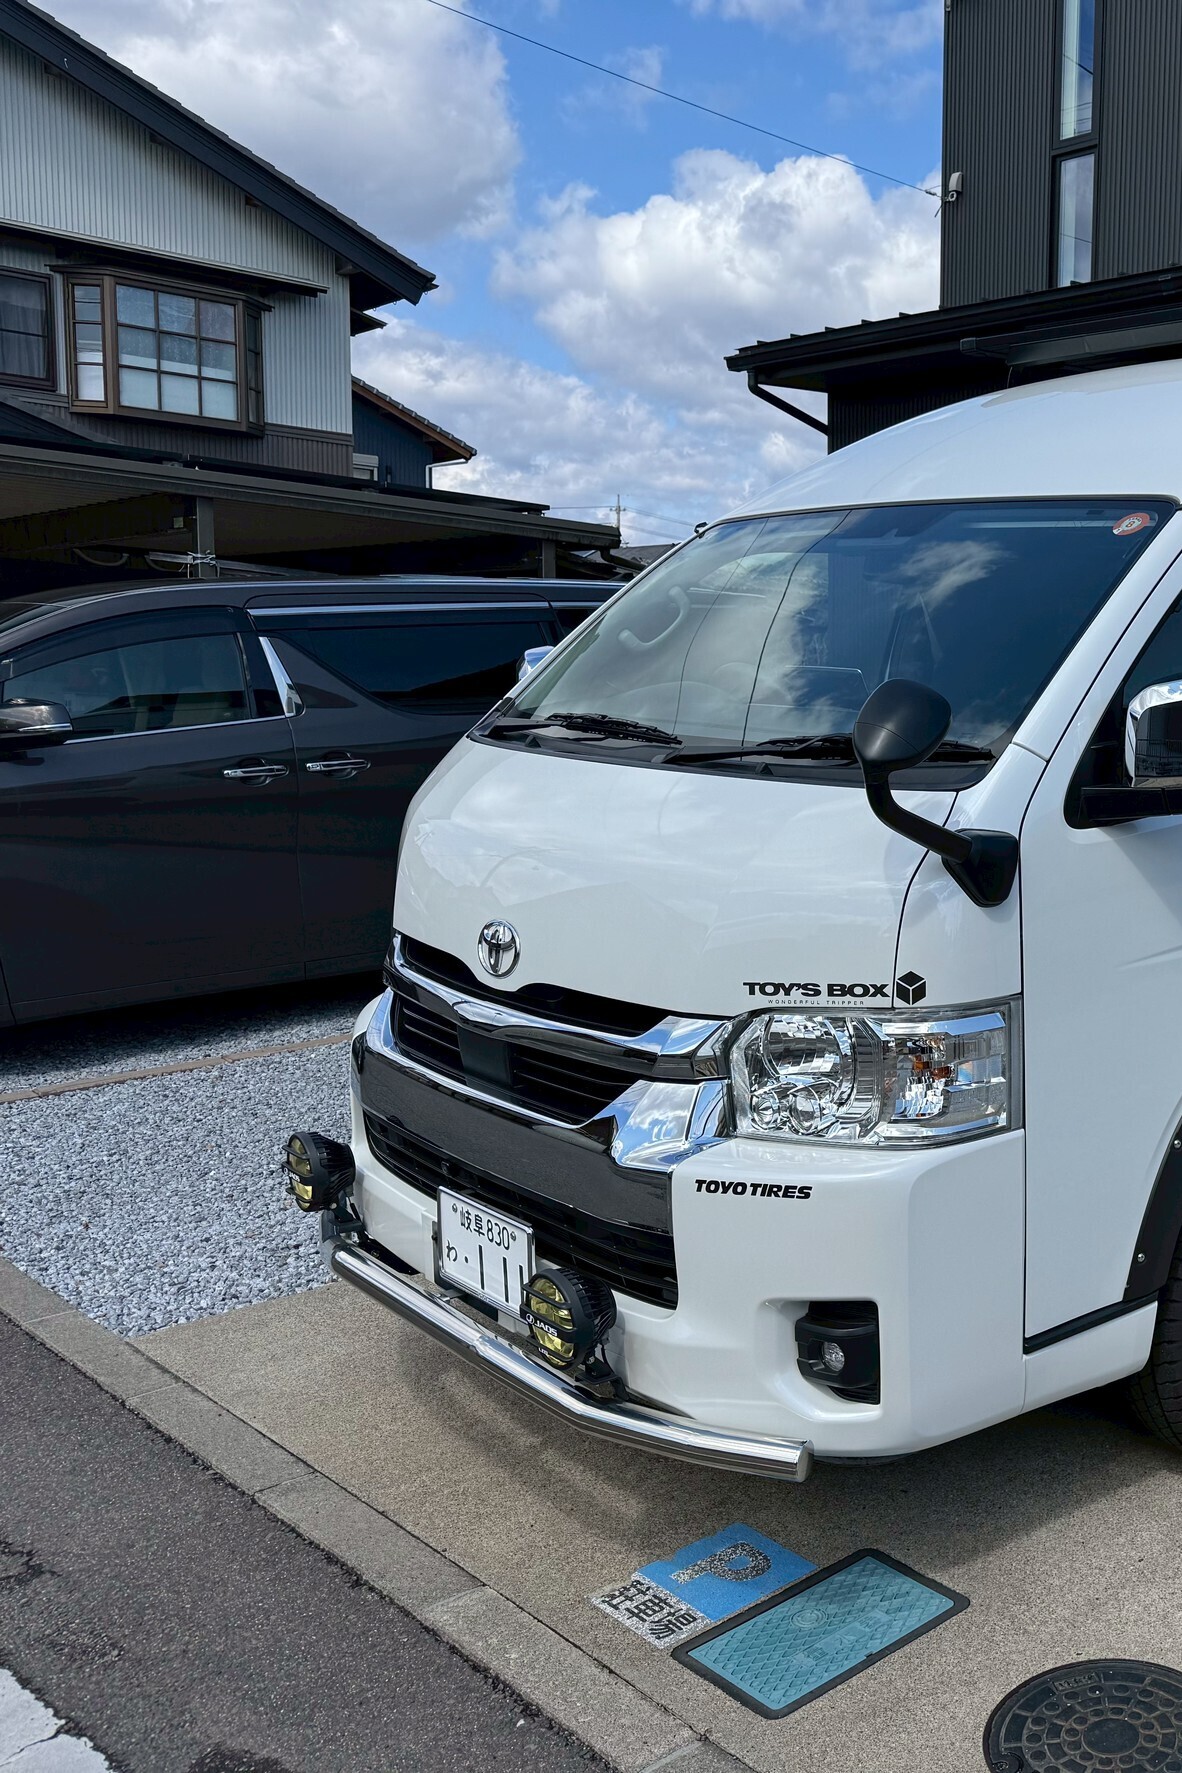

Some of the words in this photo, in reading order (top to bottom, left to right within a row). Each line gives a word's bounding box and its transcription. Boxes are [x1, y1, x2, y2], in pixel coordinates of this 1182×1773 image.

[743, 982, 822, 997] TOY'S
[827, 983, 891, 998] BOX
[695, 1179, 748, 1196] TOYO
[749, 1183, 813, 1200] TIRES
[460, 1206, 510, 1251] 岐阜830
[669, 1541, 772, 1585] P
[600, 1579, 698, 1640] 駐車場
